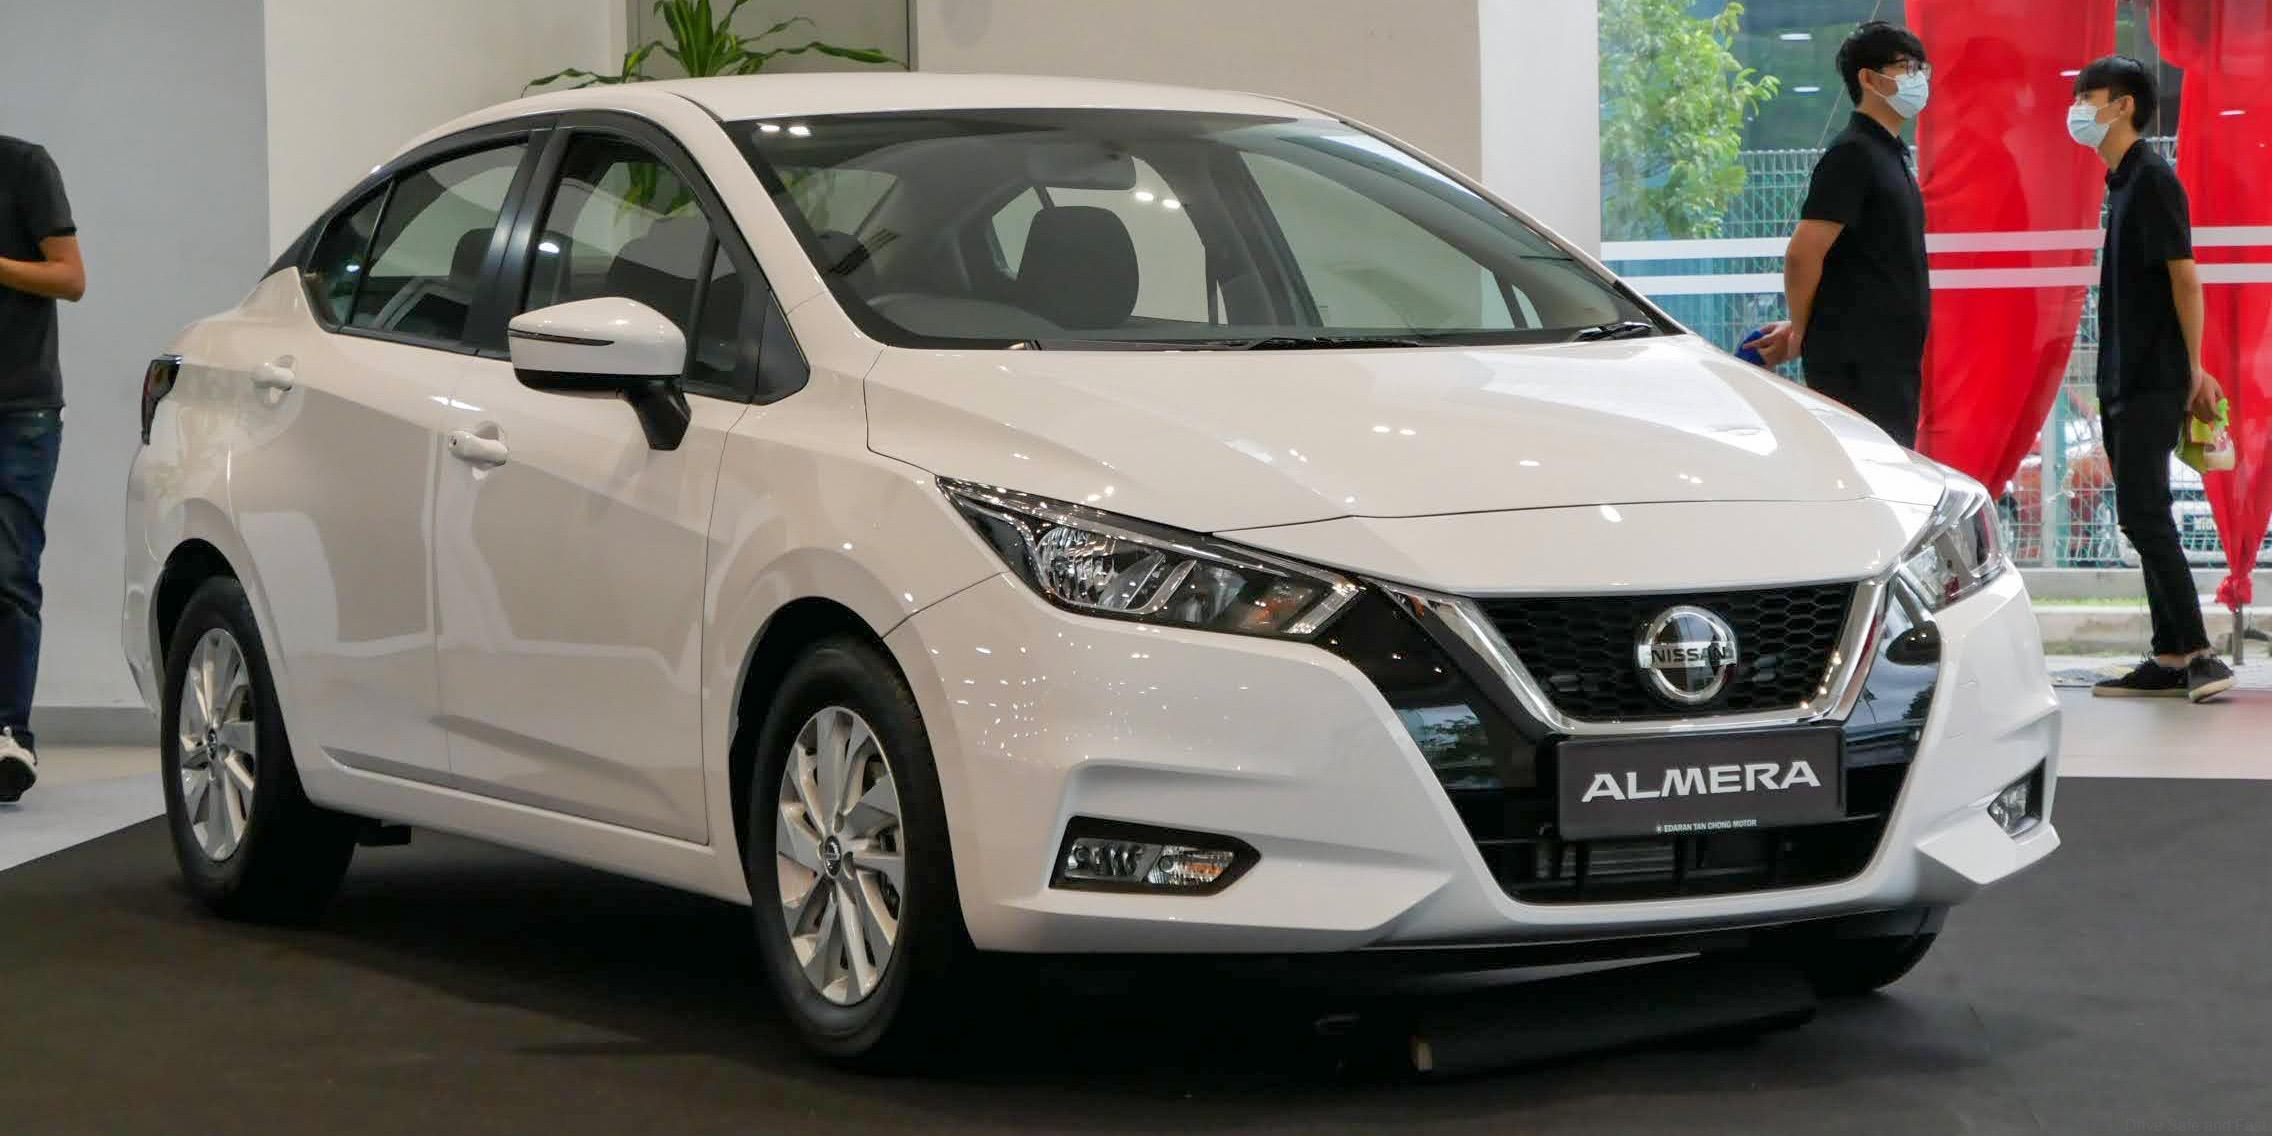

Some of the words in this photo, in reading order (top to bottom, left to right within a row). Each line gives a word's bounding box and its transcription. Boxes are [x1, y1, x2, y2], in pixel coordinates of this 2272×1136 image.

[1651, 646, 1727, 663] NISSAN
[1581, 760, 1822, 803] ALMERA
[1664, 823, 1693, 833] EDARAN
[1693, 821, 1707, 831] TAN
[1707, 820, 1732, 830] CHONG
[1732, 819, 1758, 828] MOTOR
